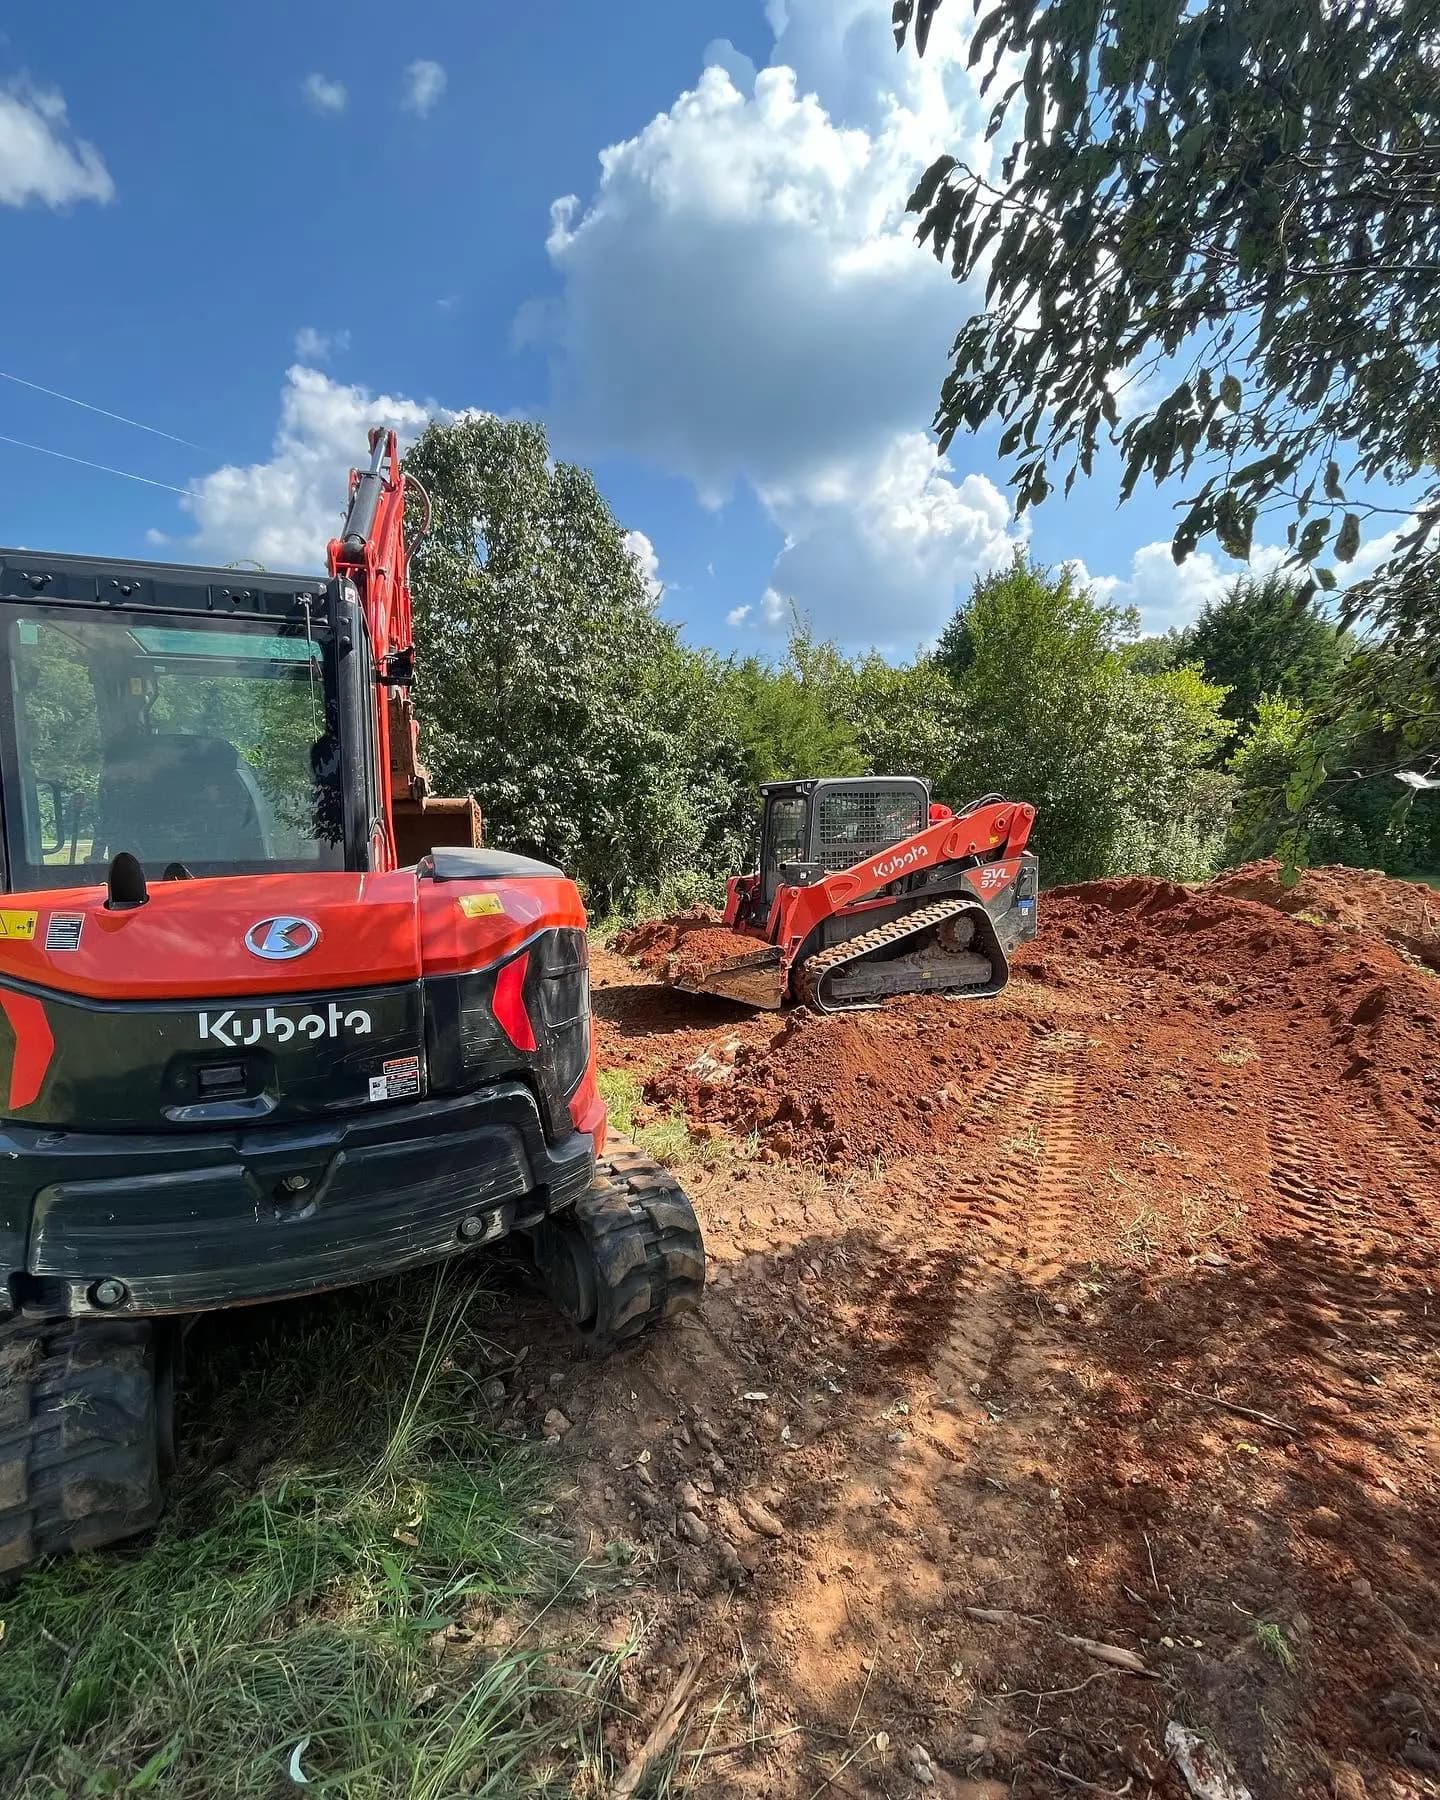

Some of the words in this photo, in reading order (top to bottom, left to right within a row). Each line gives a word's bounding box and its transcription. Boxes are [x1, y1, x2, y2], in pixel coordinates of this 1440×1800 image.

[872, 845, 928, 877] Kubota
[980, 868, 1010, 880] SVL
[198, 1003, 372, 1047] Kubota
